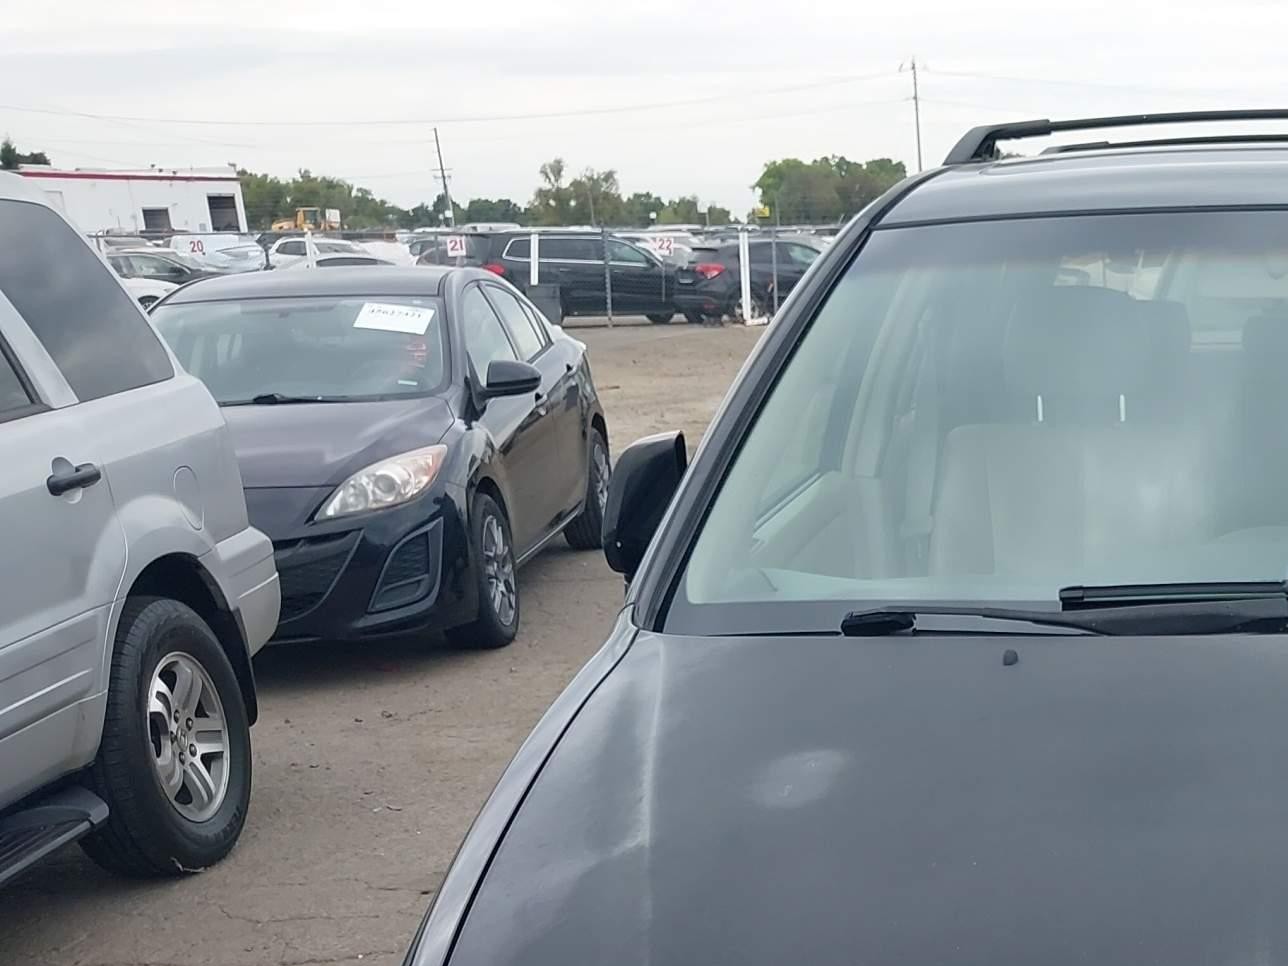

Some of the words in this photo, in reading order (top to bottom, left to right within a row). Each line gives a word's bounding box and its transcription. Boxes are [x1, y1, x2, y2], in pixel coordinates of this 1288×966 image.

[189, 239, 204, 253] 20
[449, 239, 464, 252] 21
[658, 238, 672, 250] 22
